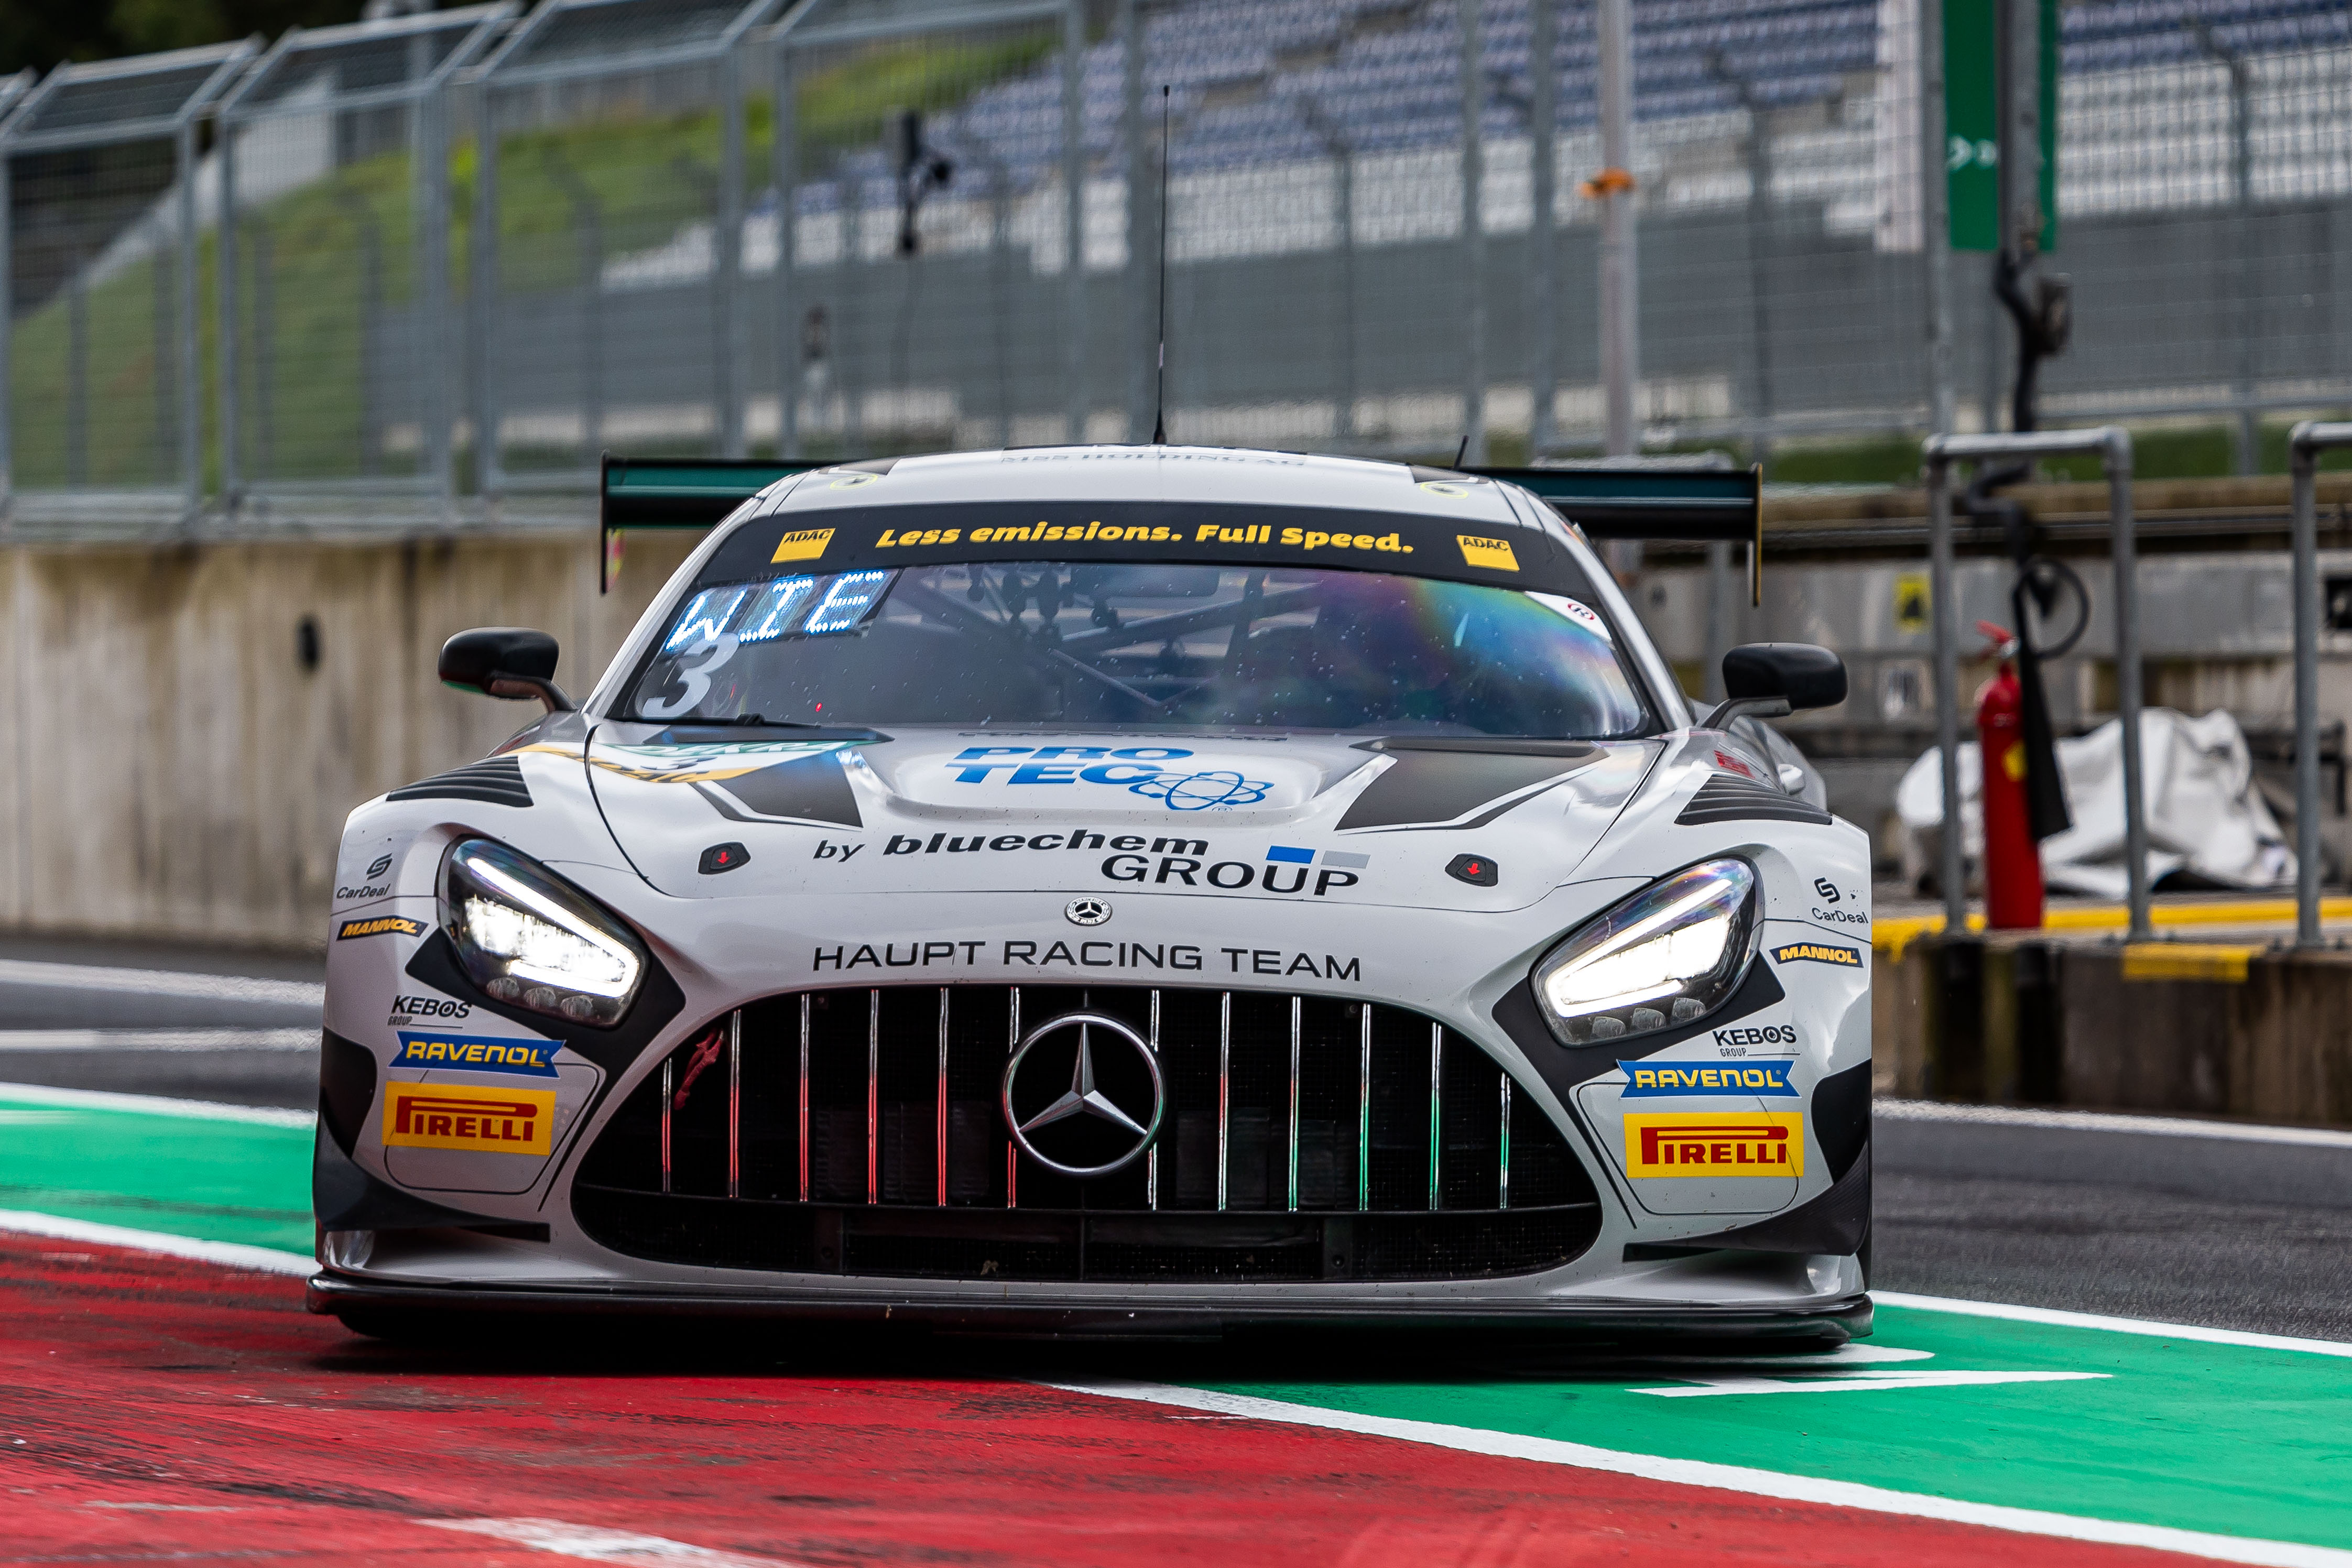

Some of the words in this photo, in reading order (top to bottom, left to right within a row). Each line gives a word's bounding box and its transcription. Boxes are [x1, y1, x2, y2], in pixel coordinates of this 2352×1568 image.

[783, 529, 831, 543] ADAC
[875, 528, 961, 548] Less
[969, 521, 1183, 542] emissions.
[1195, 525, 1271, 543] Full
[1280, 527, 1414, 553] Speed.
[1463, 537, 1509, 551] ADAC
[641, 632, 740, 718] 3
[953, 746, 1194, 760] PRO
[944, 763, 1165, 786] TEC
[813, 840, 865, 863] by
[883, 830, 1208, 856] bluechem
[1101, 854, 1359, 896] GROUP
[336, 884, 390, 899] CarDeal
[1812, 907, 1868, 924] CarDeal
[342, 919, 418, 937] MANNOL
[813, 941, 986, 972] HAUPT
[1003, 941, 1203, 970] RACING
[1221, 948, 1360, 982] TEAM
[1780, 945, 1858, 963] MANNOL
[391, 995, 470, 1018] KEBOS
[1712, 1025, 1797, 1046] KEBOS
[406, 1040, 546, 1067] RAVENOL
[1720, 1048, 1746, 1057] GROUP
[1636, 1069, 1783, 1088] RAVENOL
[396, 1096, 538, 1141] PIRELLI
[1640, 1126, 1789, 1164] PIRELLI
